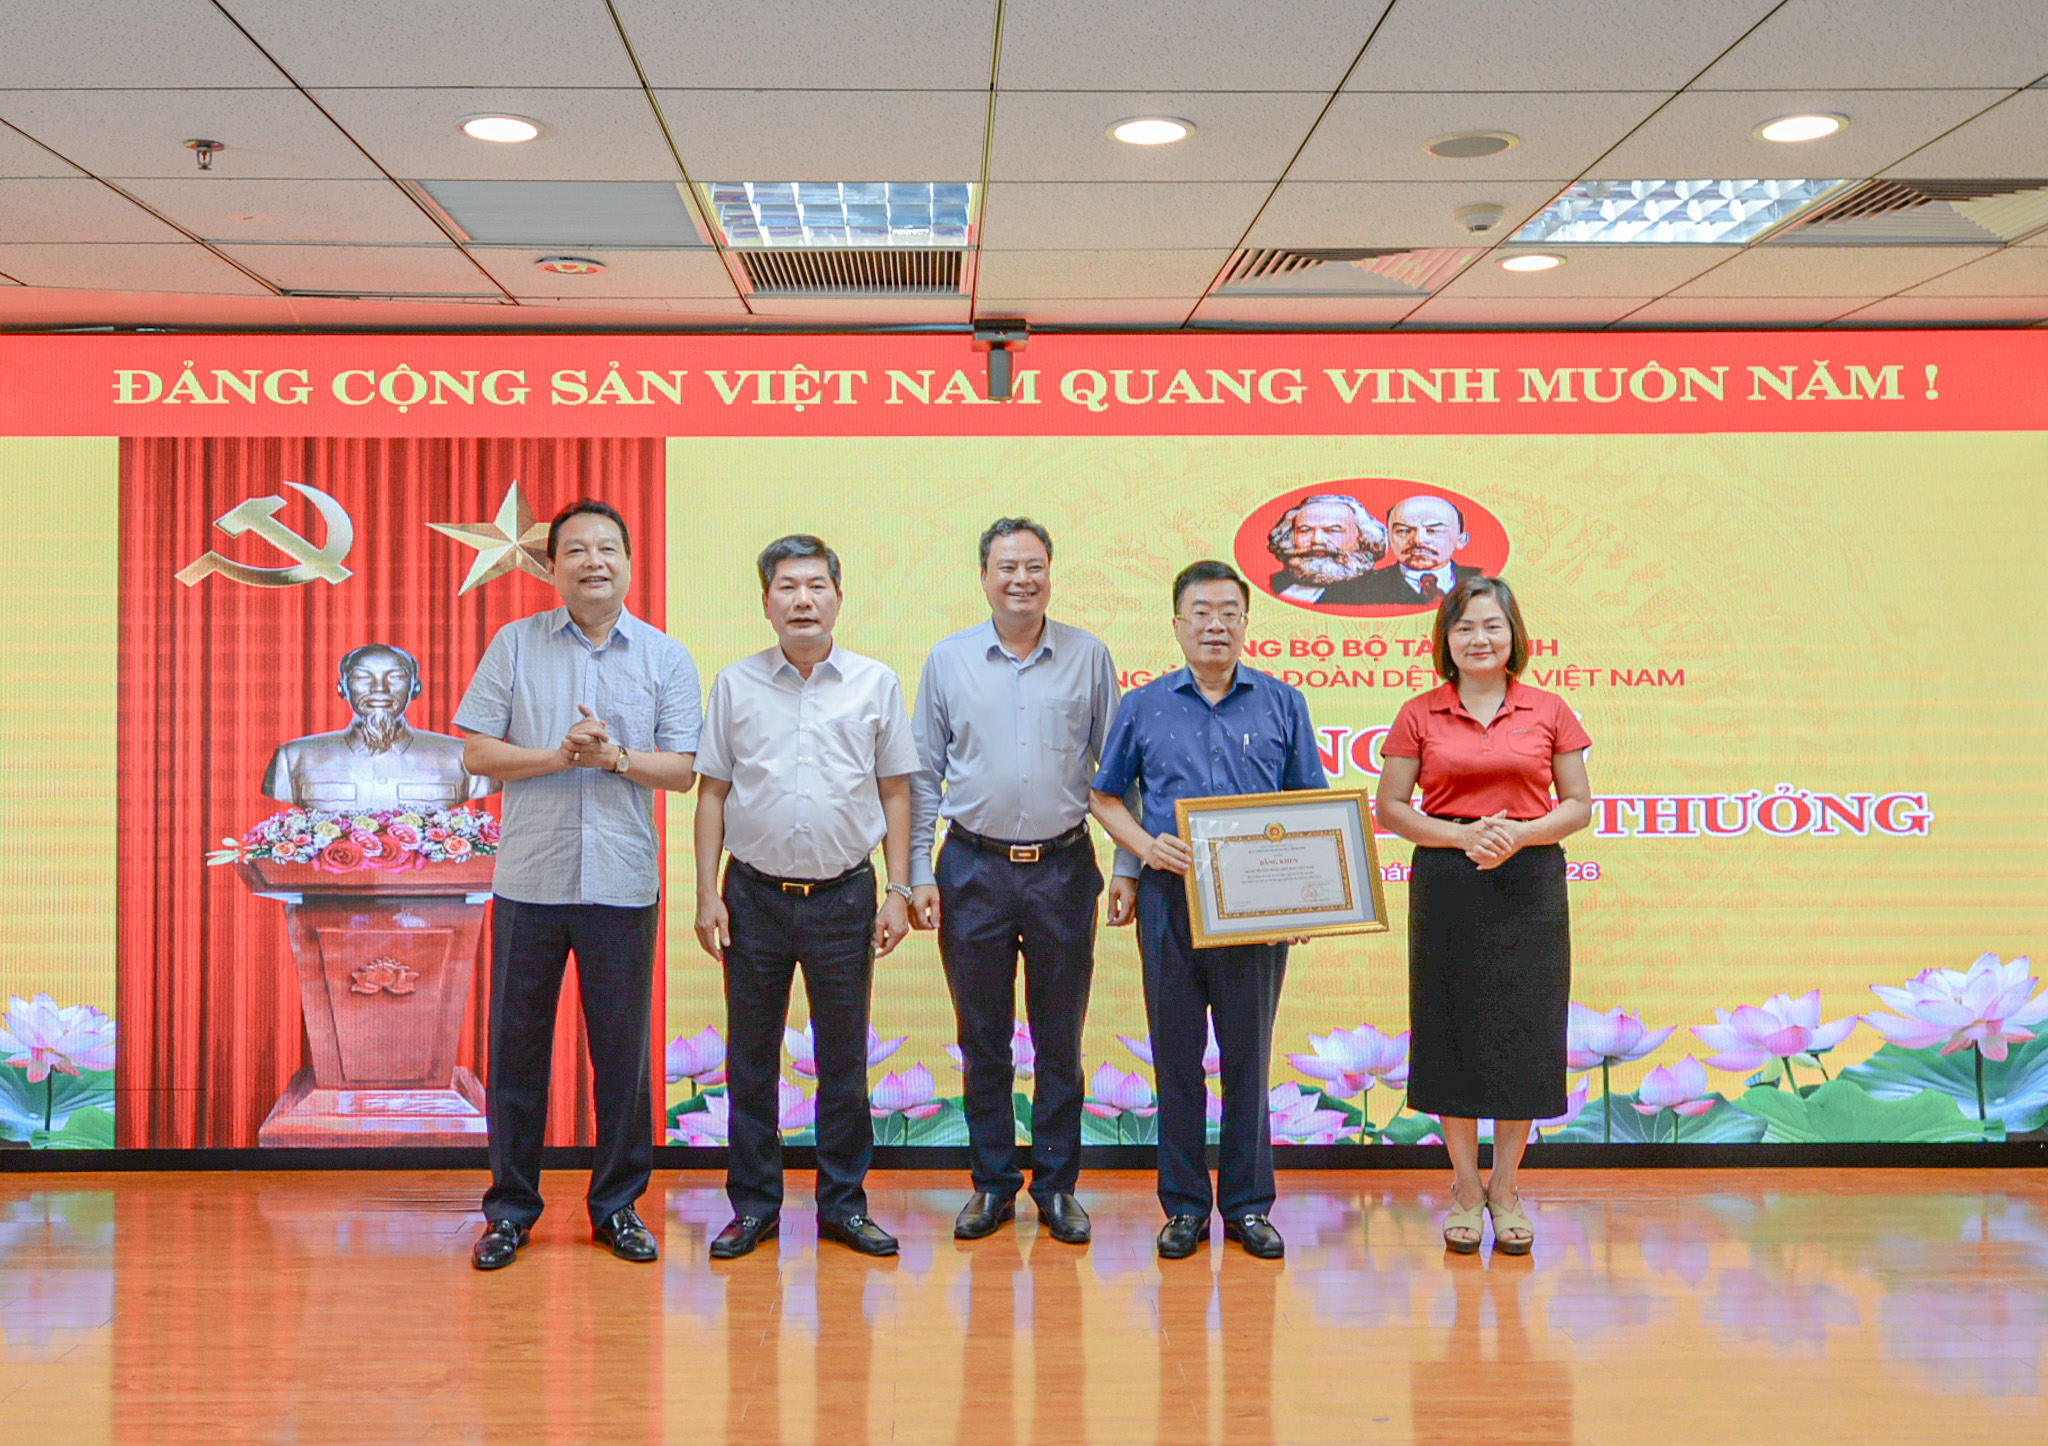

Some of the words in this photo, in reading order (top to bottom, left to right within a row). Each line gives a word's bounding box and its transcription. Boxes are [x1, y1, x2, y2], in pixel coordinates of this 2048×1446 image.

[111, 360, 314, 405] ĐẢNG
[331, 363, 532, 414] CỘNG
[550, 360, 689, 405] SẢN
[703, 363, 868, 413] VIỆT
[1059, 368, 1308, 413] QUANG
[1322, 368, 1501, 404] VINH
[1517, 360, 1730, 403] MUÔN
[1746, 359, 1905, 401] NĂM
[1924, 364, 1939, 400] !
[1290, 634, 1335, 662] BỘ
[1342, 634, 1388, 662] BỘ
[1395, 634, 1434, 657] TÀ
[1281, 664, 1374, 688] ĐOÀN
[1383, 664, 1439, 692] DỆT
[1532, 663, 1602, 692] VIỆT
[1611, 668, 1684, 687] NAM
[1591, 783, 1934, 836] THƯỞNG
